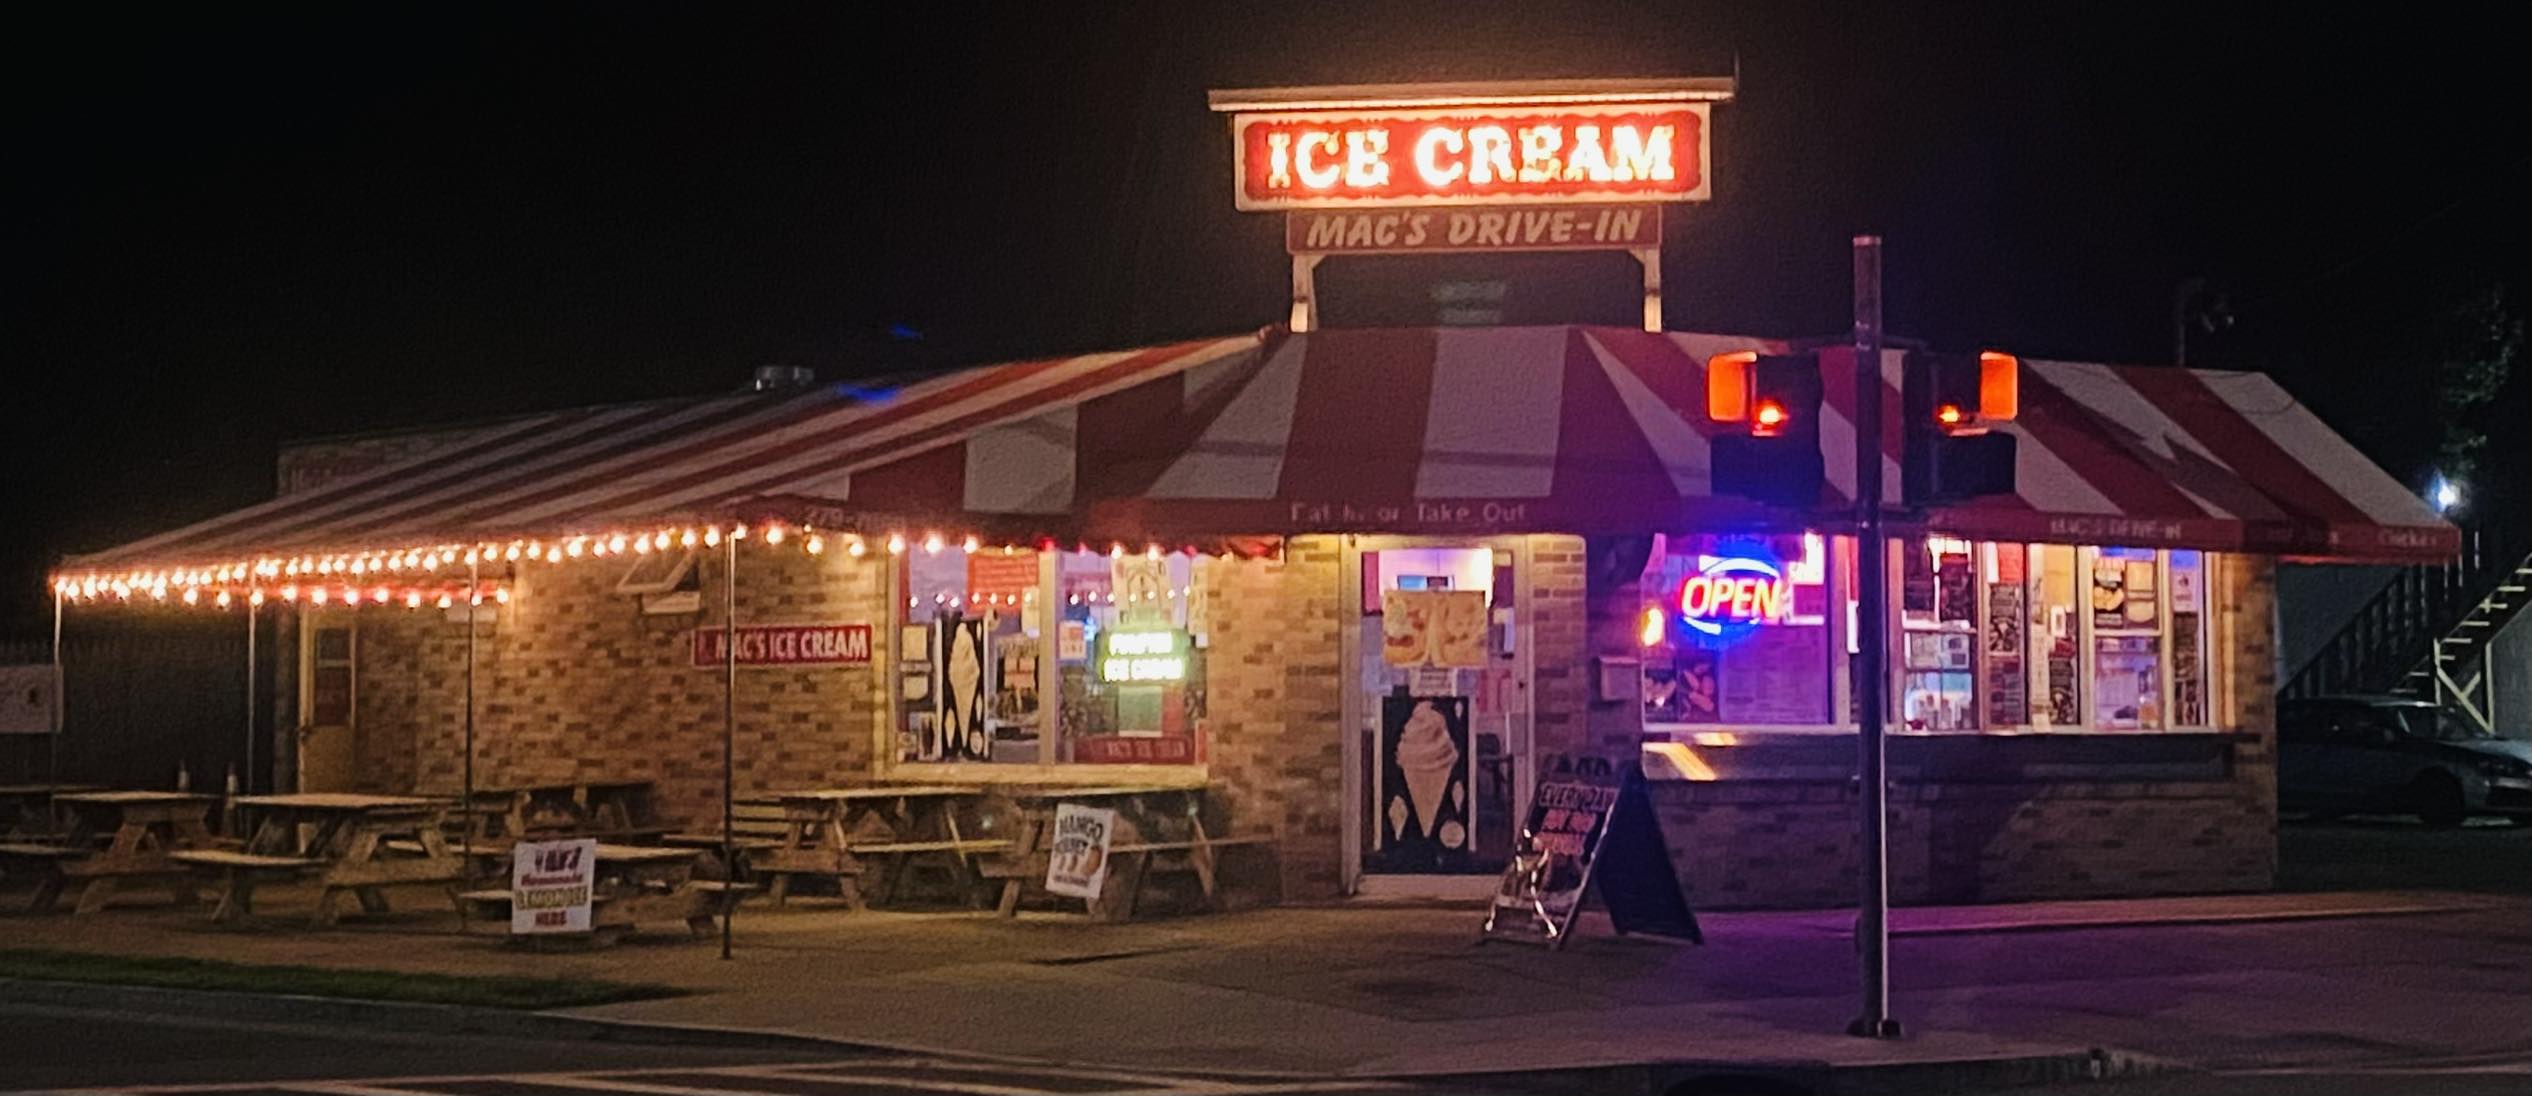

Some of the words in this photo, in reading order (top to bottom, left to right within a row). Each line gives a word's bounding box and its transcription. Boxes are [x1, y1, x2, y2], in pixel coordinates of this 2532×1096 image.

[1266, 128, 1390, 189] ICE
[1415, 123, 1676, 186] CREAM
[1306, 213, 1430, 249] MAC'S
[1447, 208, 1643, 245] DRIVE-IN
[1377, 506, 1399, 521] or
[1417, 502, 1470, 522] Take
[1482, 502, 1527, 522] Out
[1681, 575, 1782, 621] OPEN
[769, 631, 796, 660] ICE
[799, 629, 868, 658] CREAM
